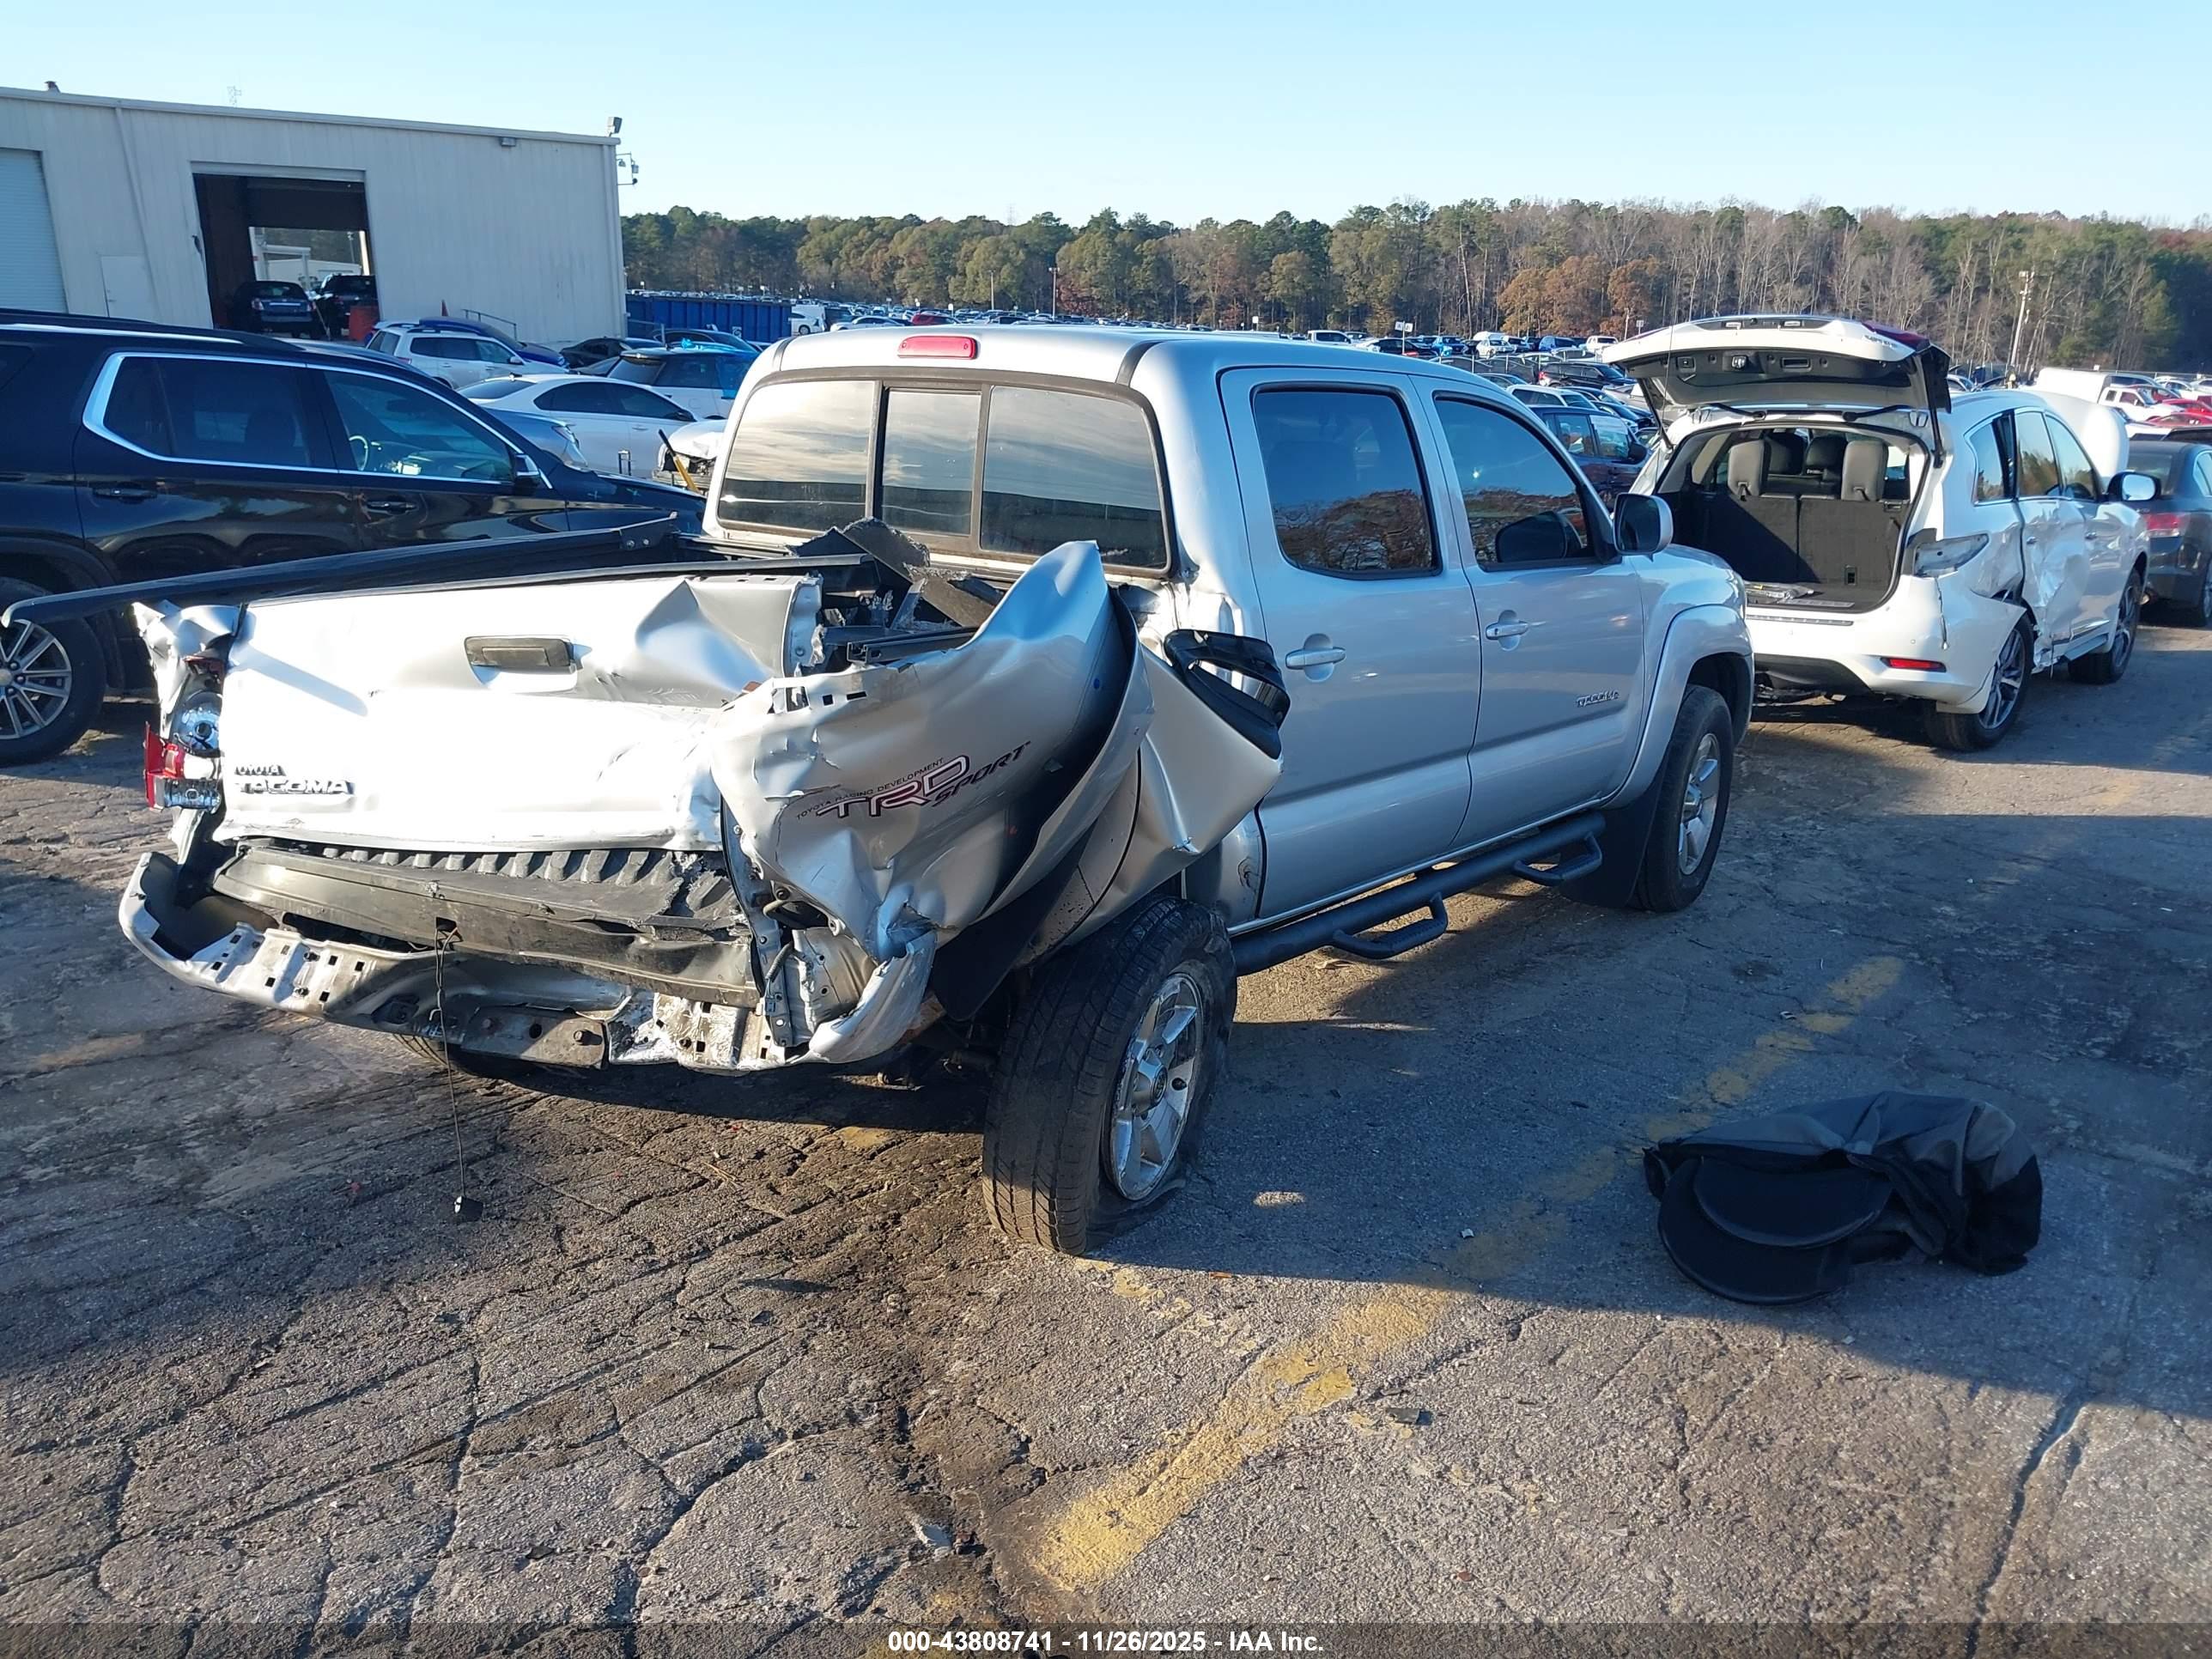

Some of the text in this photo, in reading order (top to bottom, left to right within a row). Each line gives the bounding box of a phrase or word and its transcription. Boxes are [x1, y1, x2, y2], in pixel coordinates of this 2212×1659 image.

[234, 780, 356, 795] TACOMA
[796, 757, 945, 820] TOYOTA RACING DEVELOPMENT
[816, 740, 1031, 818] TRD SPORT
